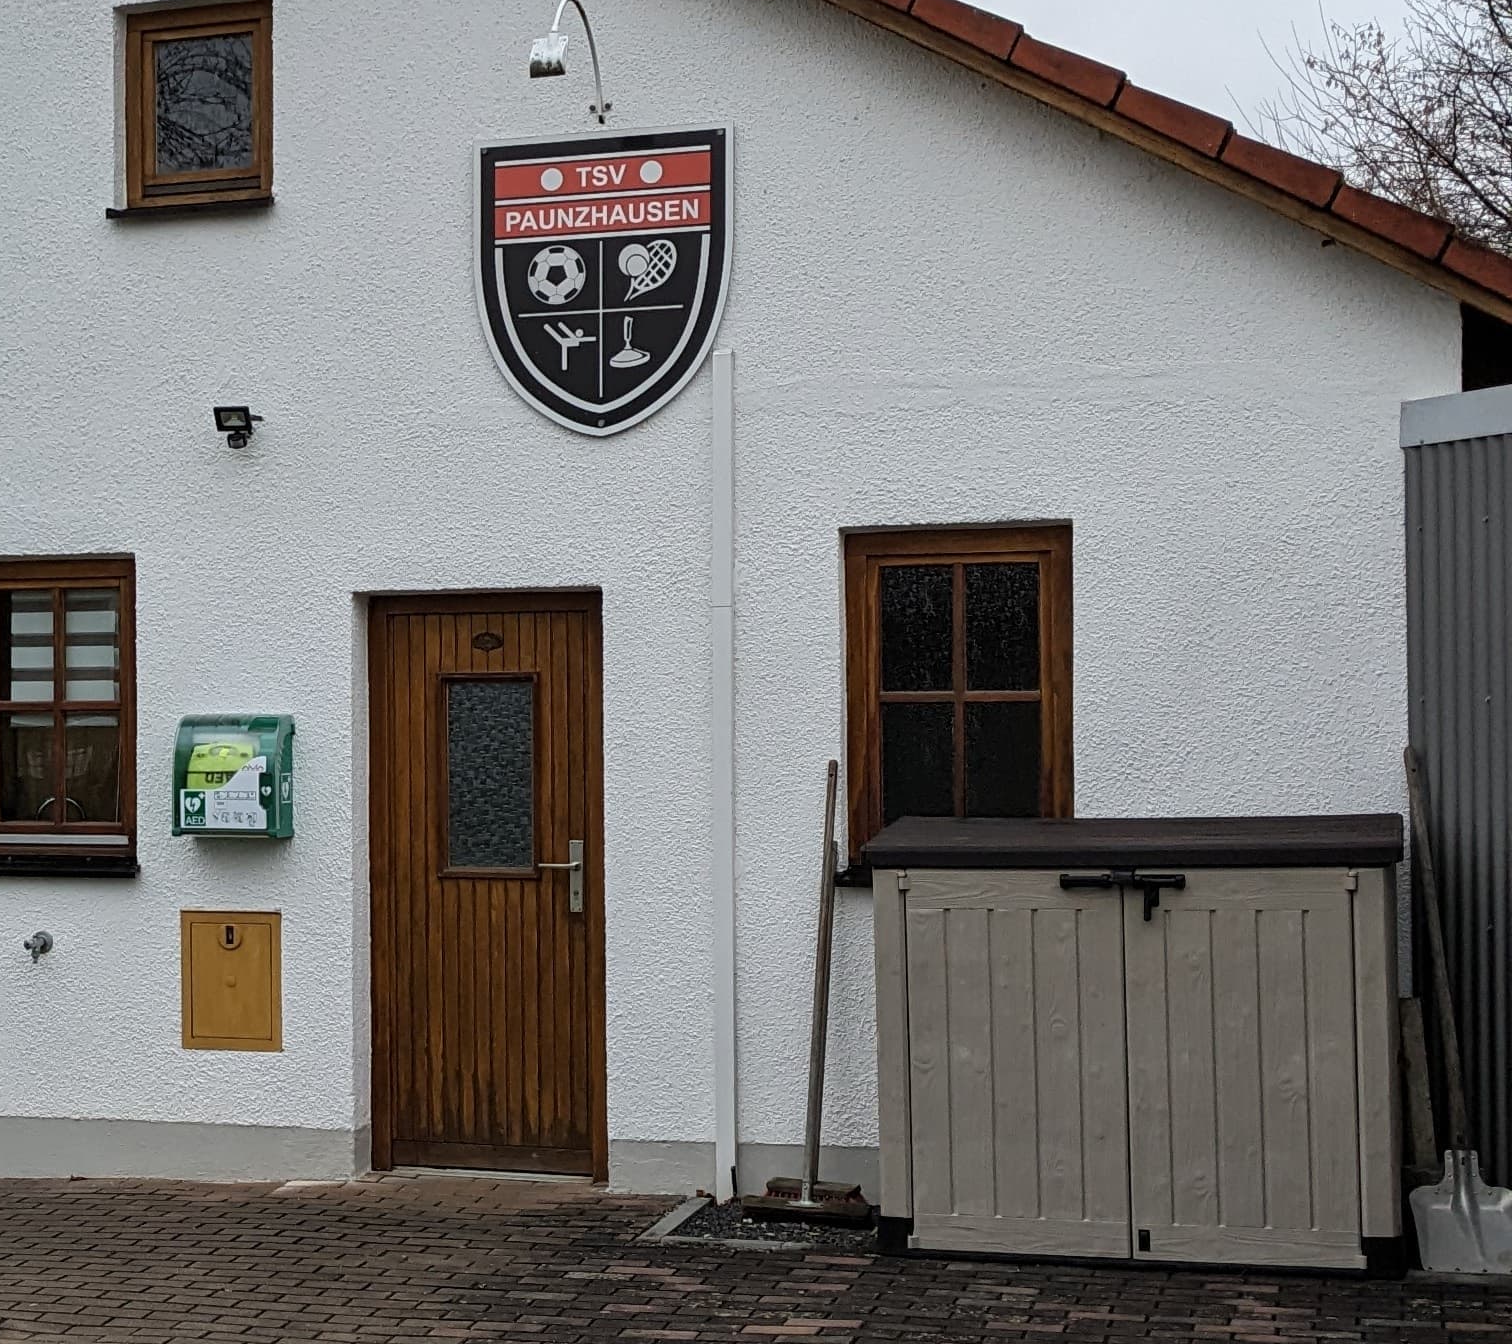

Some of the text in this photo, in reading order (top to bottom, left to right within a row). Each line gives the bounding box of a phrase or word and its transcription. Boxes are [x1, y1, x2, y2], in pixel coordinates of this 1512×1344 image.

[576, 164, 628, 188] TSV
[505, 198, 700, 232] PAUNZHAUSEN
[185, 816, 206, 826] AED
